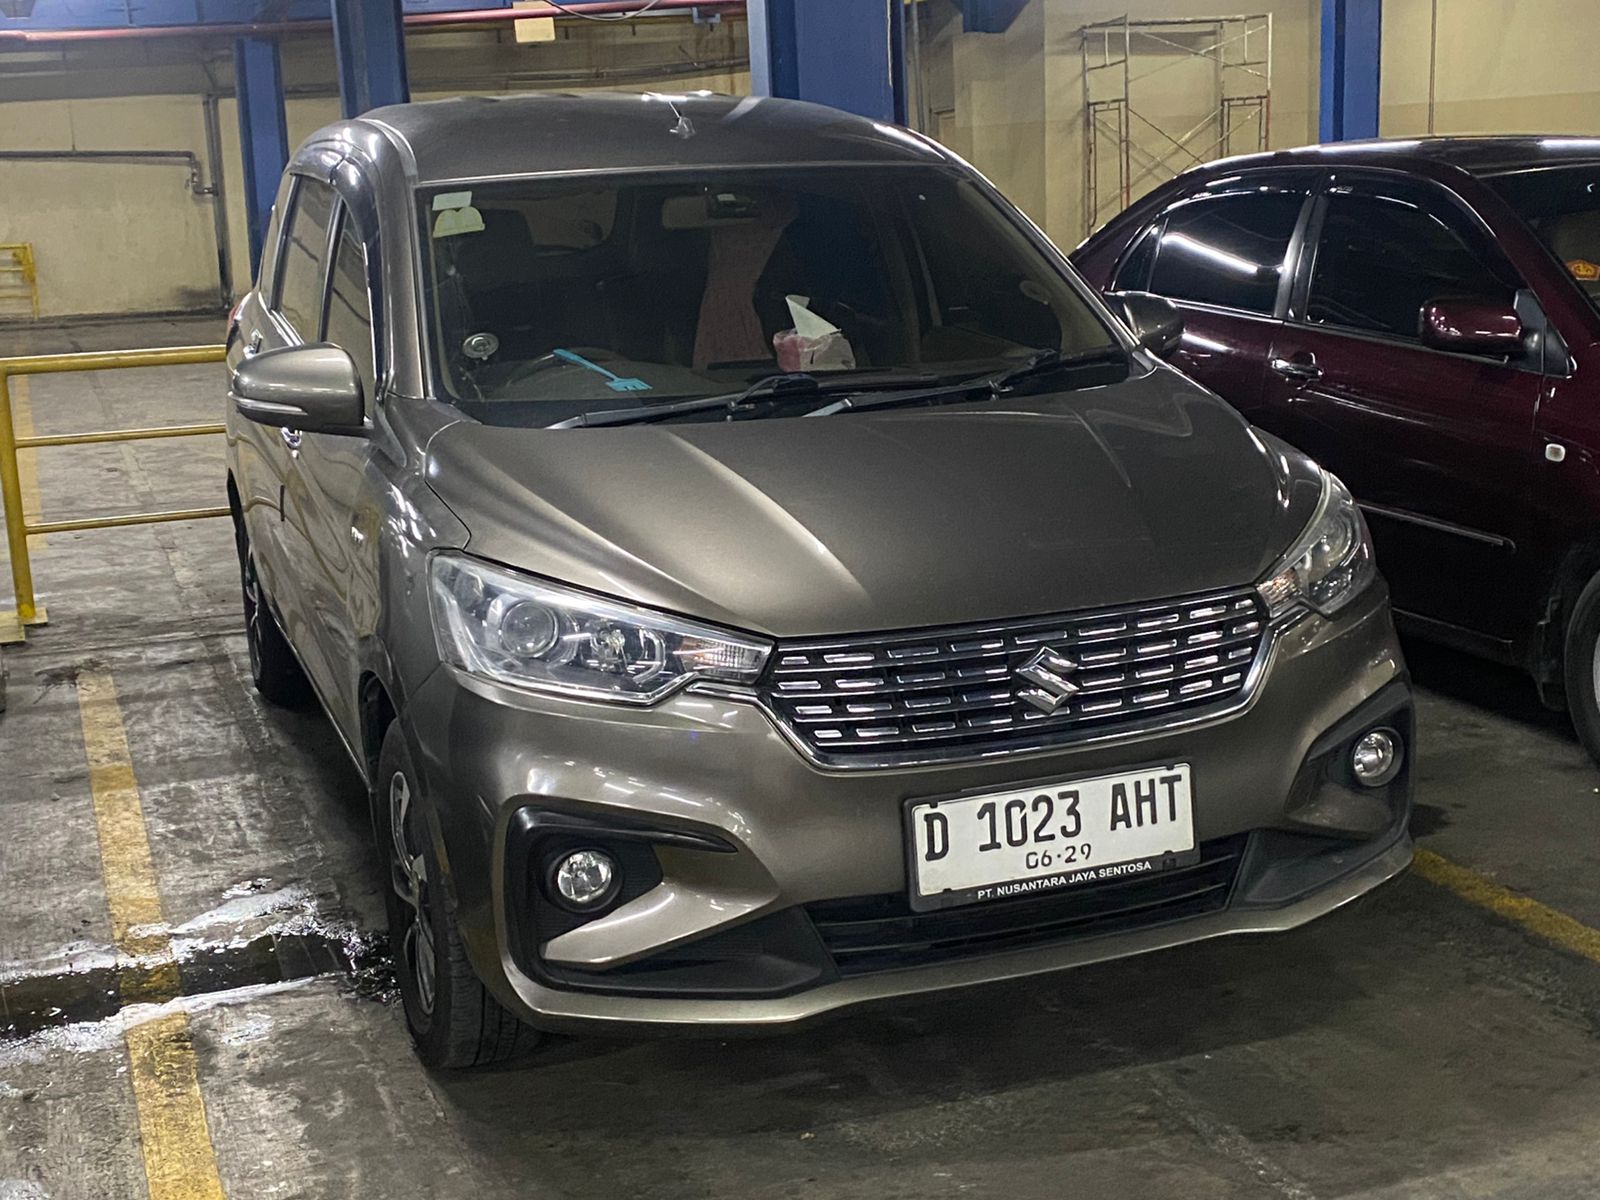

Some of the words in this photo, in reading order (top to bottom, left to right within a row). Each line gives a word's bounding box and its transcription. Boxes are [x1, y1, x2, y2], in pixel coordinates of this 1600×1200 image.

[924, 812, 949, 861] D
[977, 790, 1081, 851] 1023
[1110, 774, 1182, 831] AHT
[977, 886, 995, 900] PT.
[997, 876, 1067, 896] NUSANTARA
[1069, 870, 1097, 884] JAYA
[1098, 860, 1152, 878] SENTOSA
